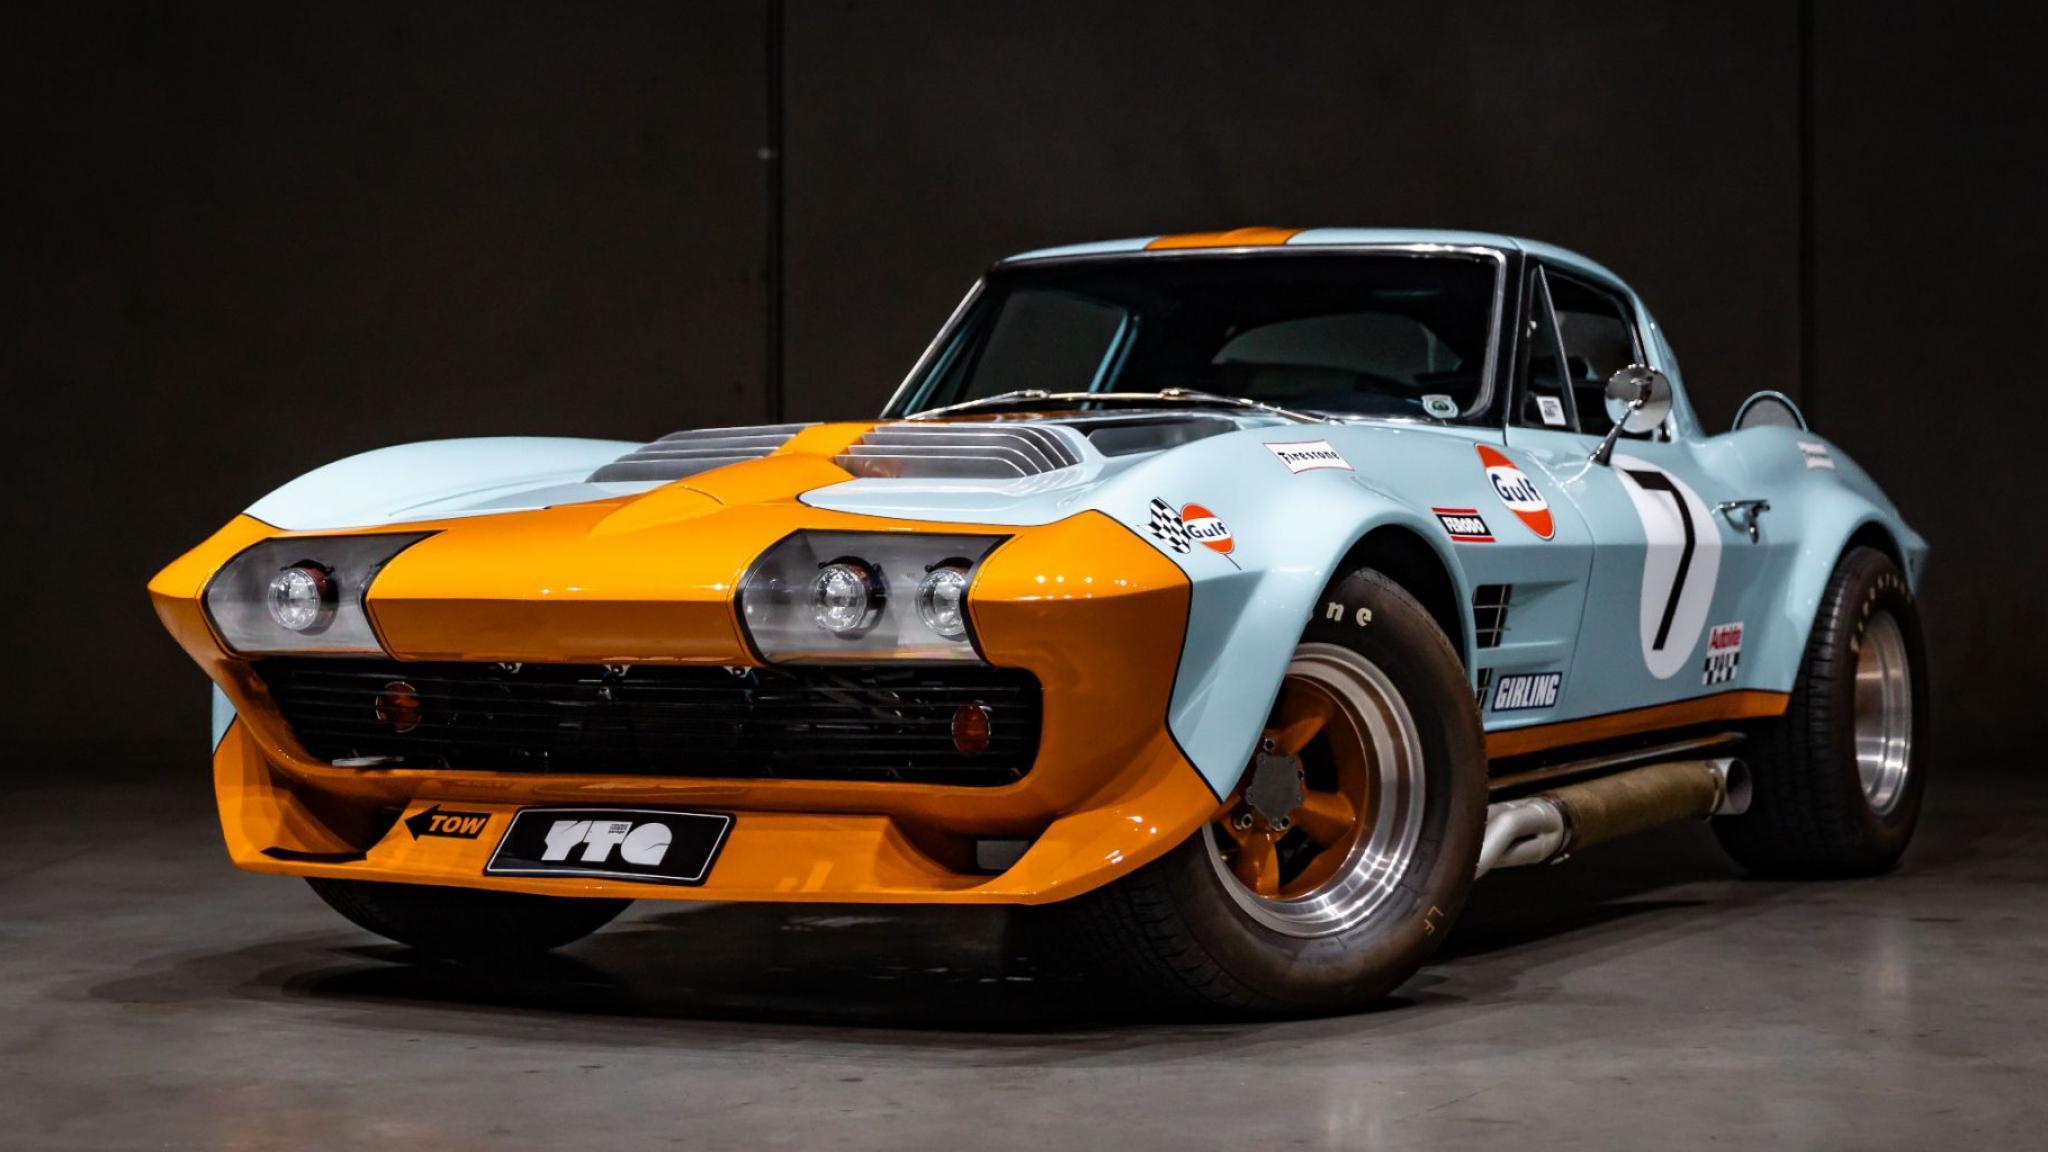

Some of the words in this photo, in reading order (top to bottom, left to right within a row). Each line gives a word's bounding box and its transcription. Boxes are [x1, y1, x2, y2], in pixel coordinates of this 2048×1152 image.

[1277, 451, 1340, 465] Firestone
[1491, 473, 1541, 502] Gulf
[1186, 521, 1228, 539] Gulf
[1441, 516, 1486, 534] FERODO
[1624, 470, 1696, 650] 7
[1494, 674, 1560, 709] GIRLING
[428, 814, 487, 835] TOW
